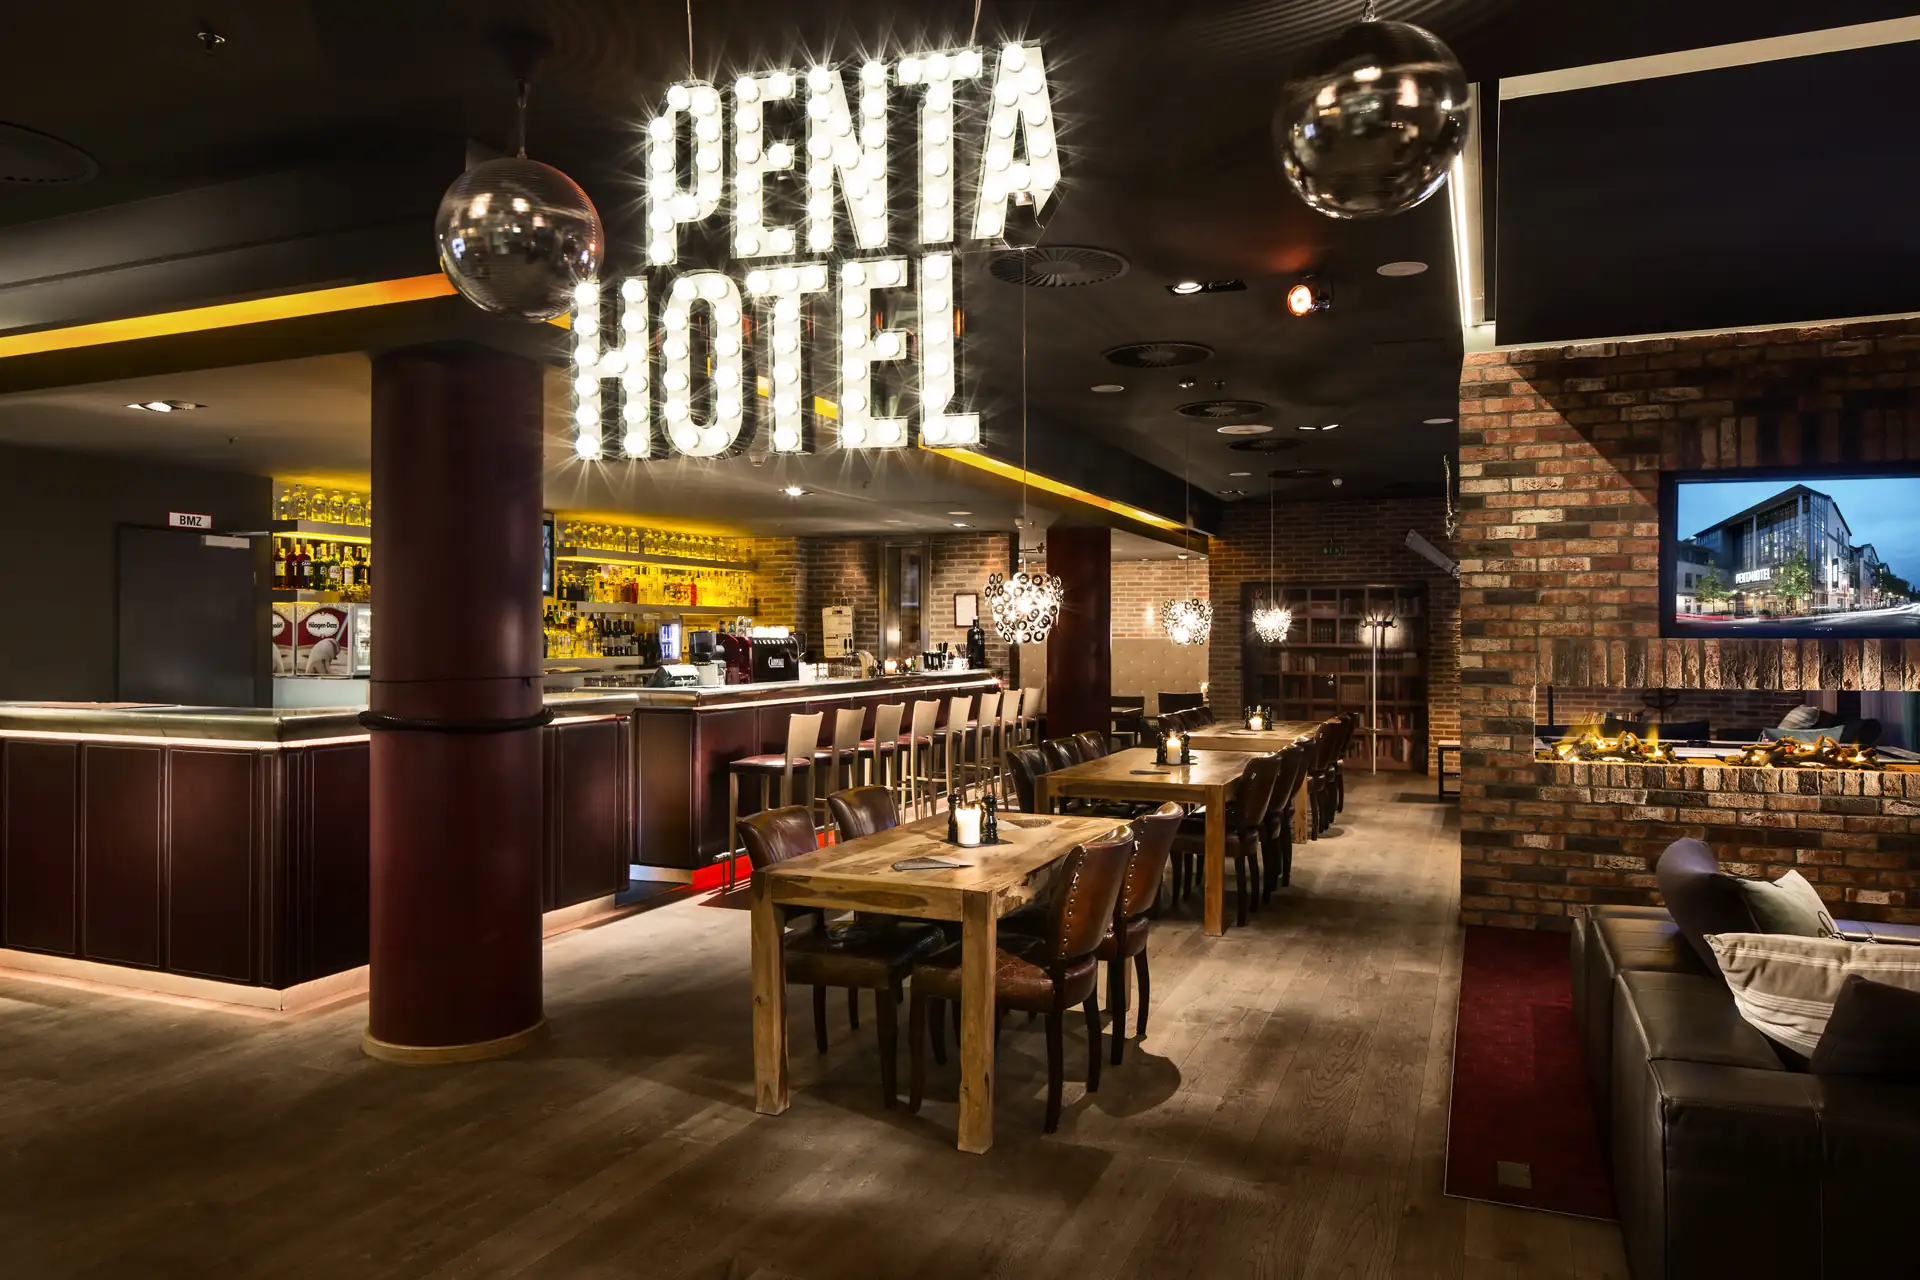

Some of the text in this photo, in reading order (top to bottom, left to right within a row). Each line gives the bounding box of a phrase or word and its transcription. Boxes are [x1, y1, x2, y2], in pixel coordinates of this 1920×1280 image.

[645, 39, 1061, 266] PENTA
[570, 251, 983, 461] HOTEL
[179, 515, 202, 526] BMZ
